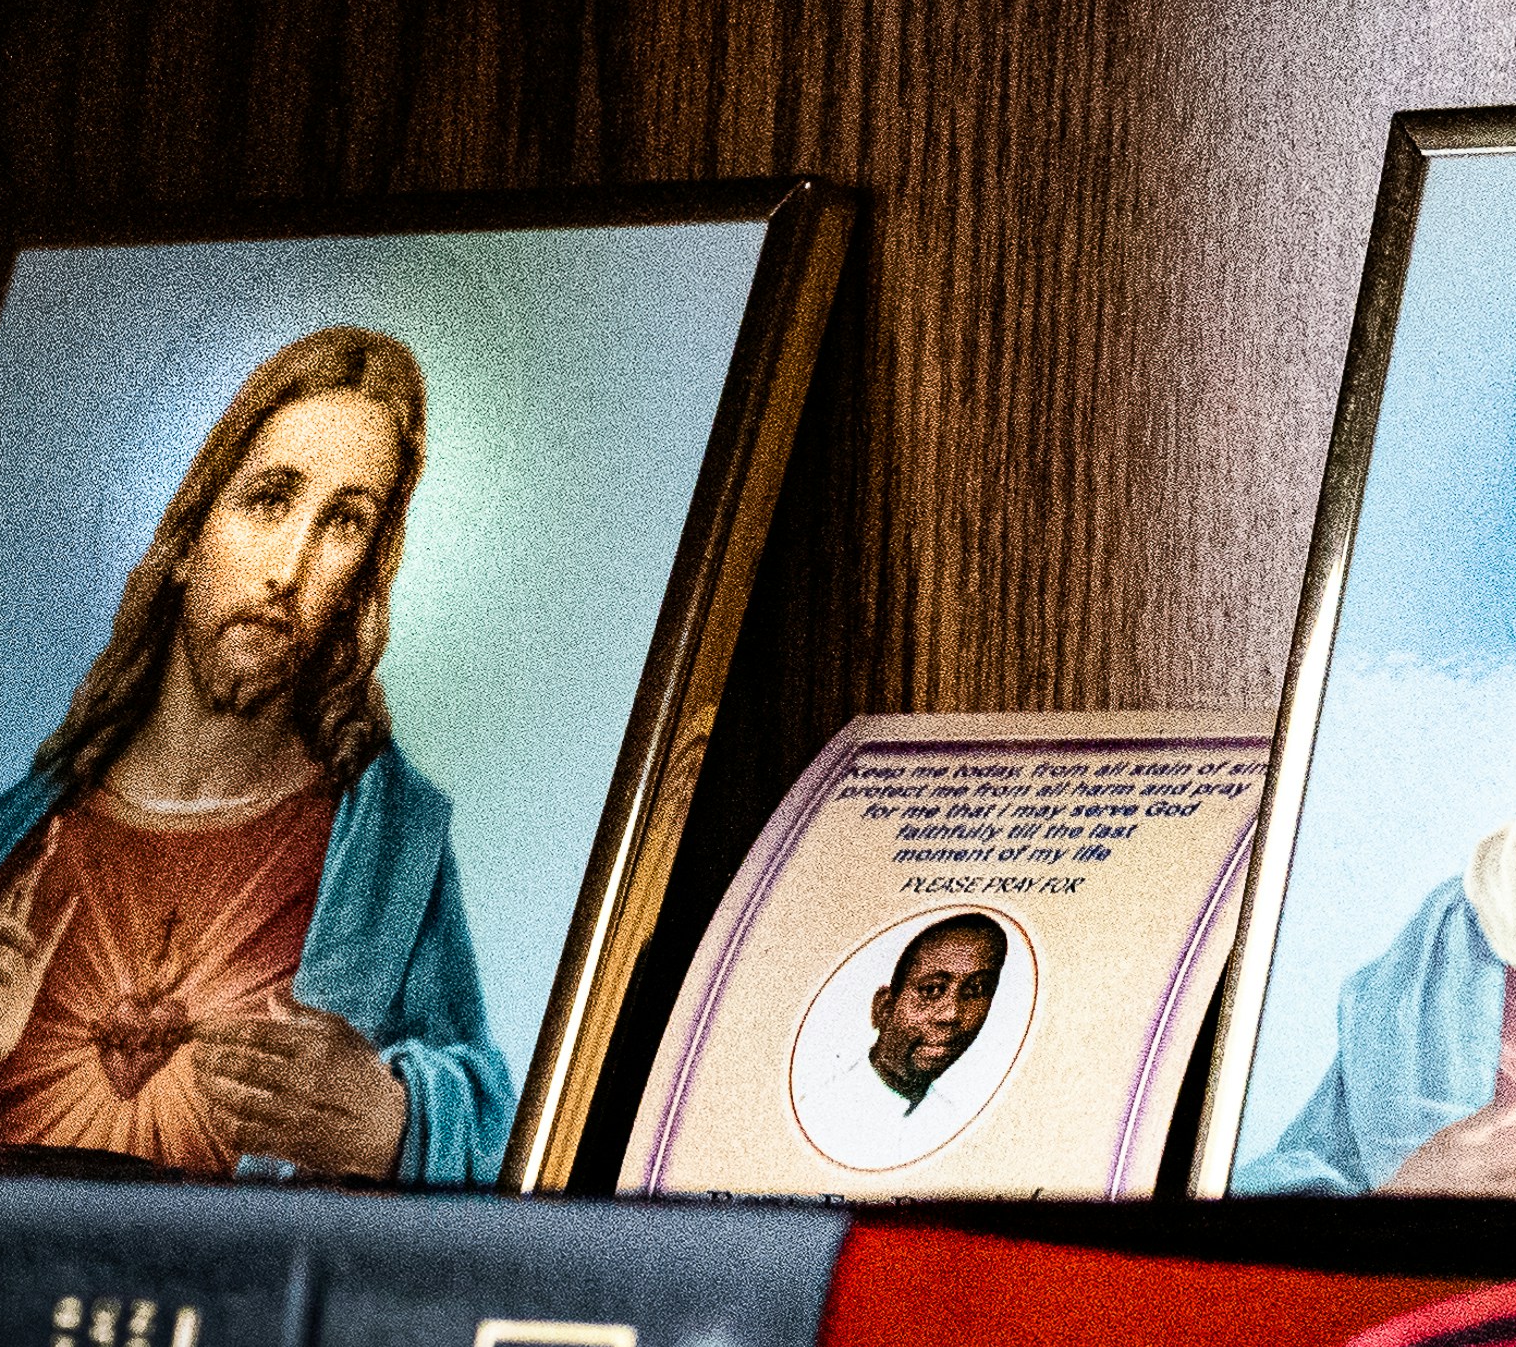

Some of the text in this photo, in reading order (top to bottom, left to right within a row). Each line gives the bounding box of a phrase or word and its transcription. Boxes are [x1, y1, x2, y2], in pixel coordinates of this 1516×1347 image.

[911, 766, 949, 779] me
[1030, 761, 1089, 779] from
[1094, 761, 1129, 777] all
[1129, 760, 1193, 777] stain
[1197, 760, 1229, 776] of
[836, 780, 1252, 801] protect me from all harm and pray
[860, 803, 900, 820] for
[900, 806, 941, 819] me
[945, 803, 997, 819] that
[1011, 806, 1067, 821] may
[1070, 804, 1139, 818] serve
[1144, 800, 1203, 818] God
[894, 823, 1139, 844] faithfully till the last
[891, 843, 1113, 865] moment of my life
[899, 876, 1087, 894] PLEASE PRAY FOR
